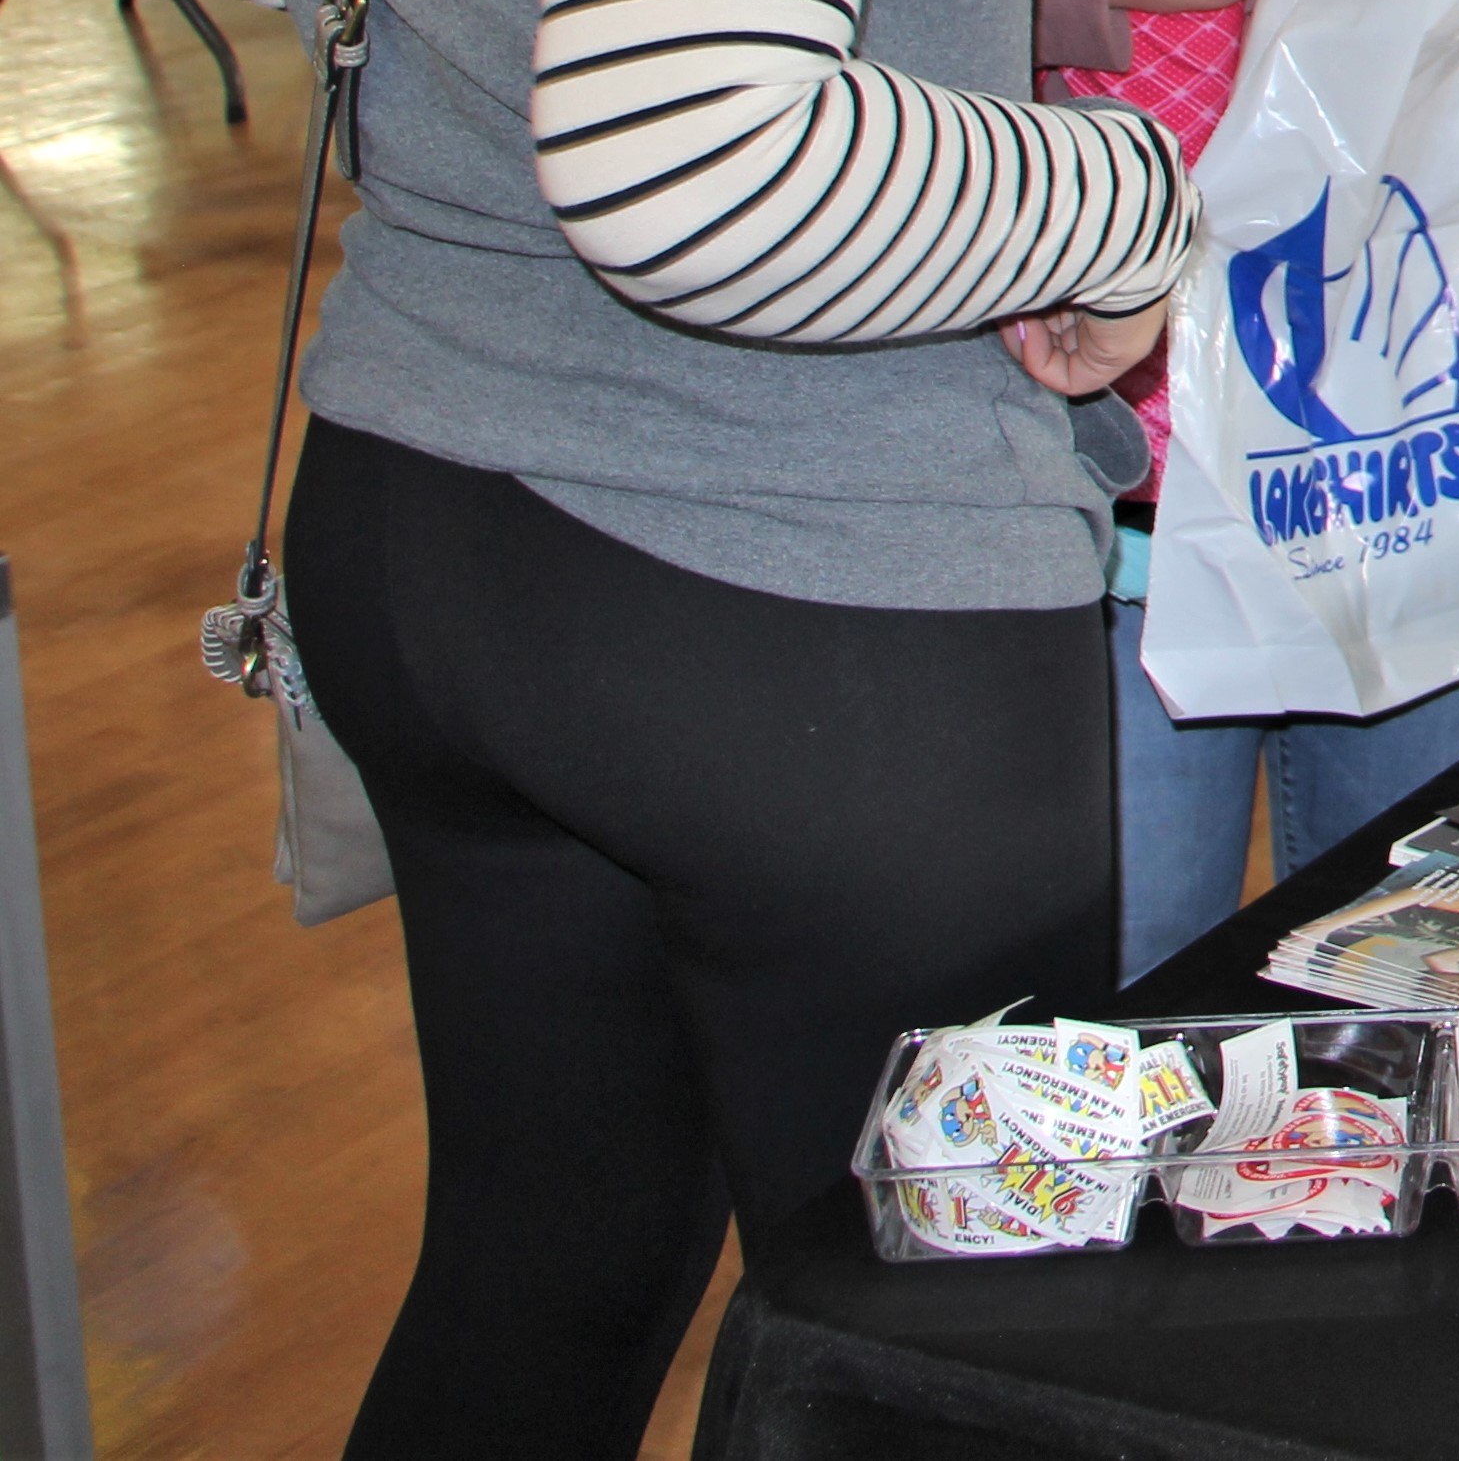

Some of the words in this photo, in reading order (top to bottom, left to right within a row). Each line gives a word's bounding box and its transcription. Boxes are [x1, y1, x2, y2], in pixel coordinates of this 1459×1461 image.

[1359, 518, 1433, 564] 1984
[1002, 1061, 1087, 1101] EMERGENCY!
[1090, 1095, 1111, 1113] AN
[1111, 1104, 1126, 1118] IN
[1099, 1129, 1118, 1145] AN
[1117, 1135, 1133, 1148] IN
[1074, 1171, 1093, 1187] AN
